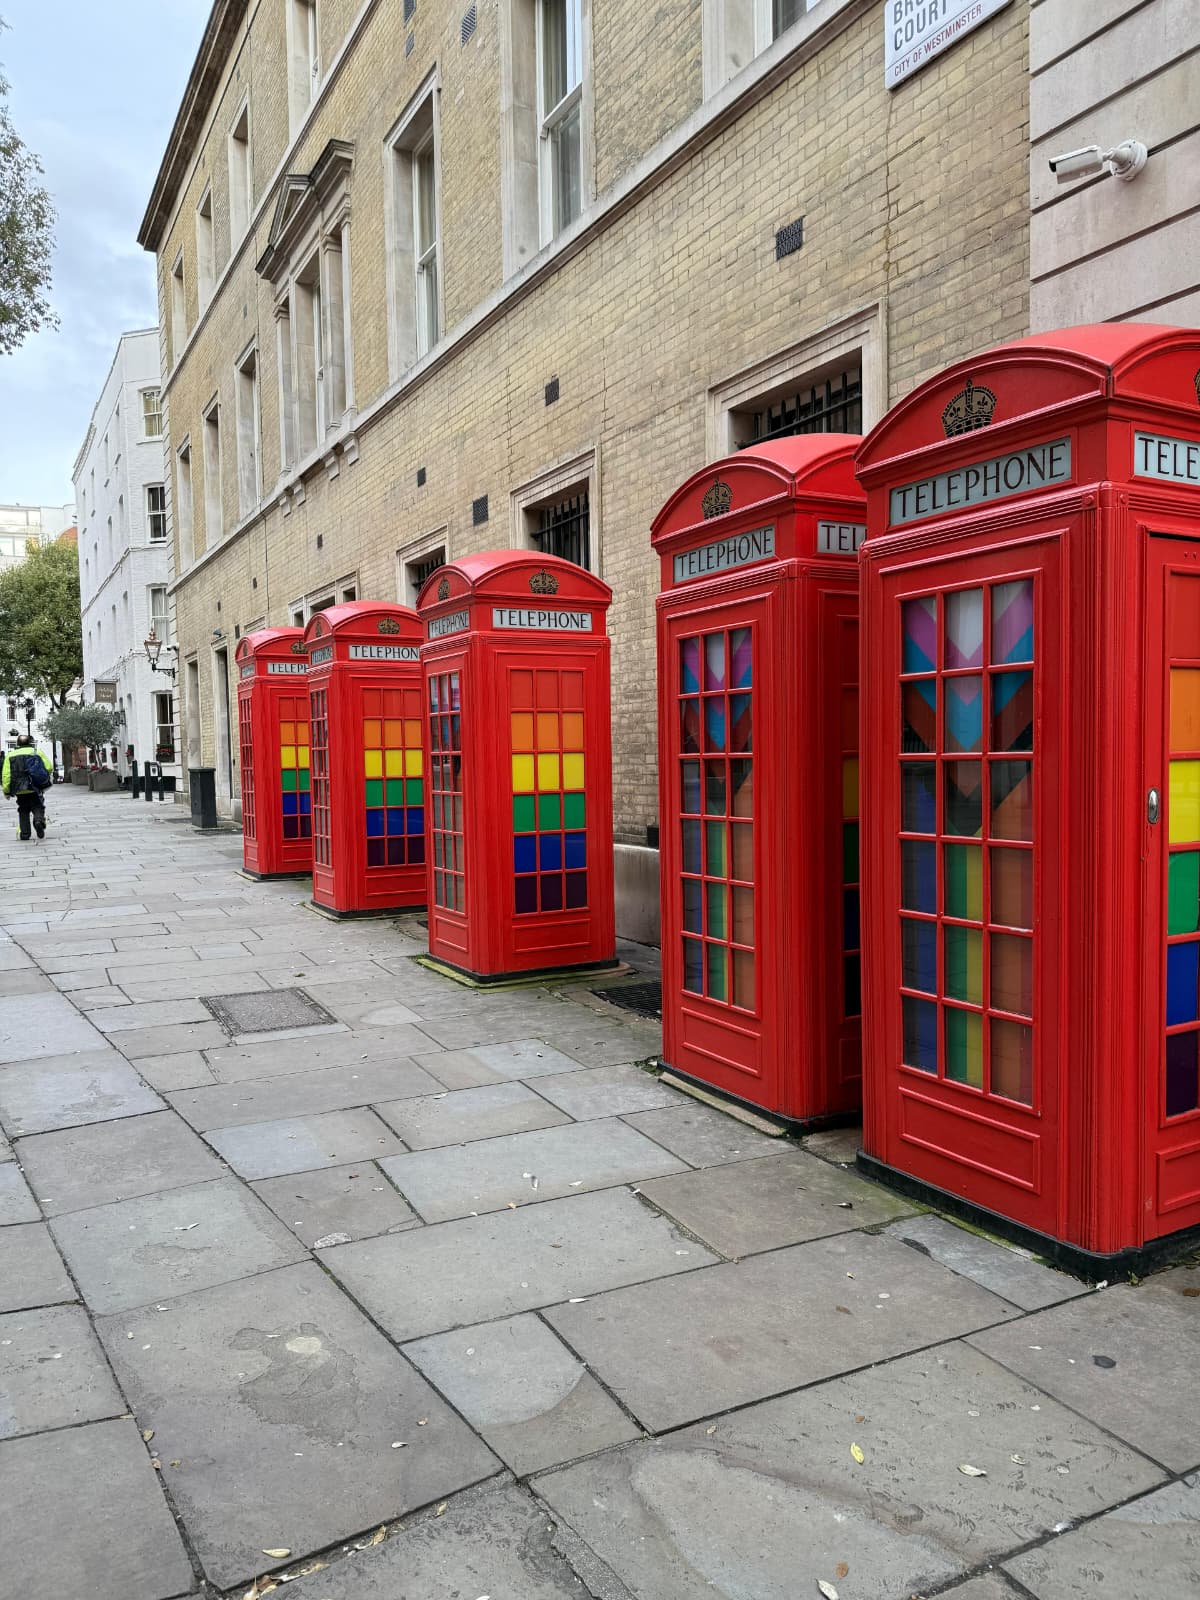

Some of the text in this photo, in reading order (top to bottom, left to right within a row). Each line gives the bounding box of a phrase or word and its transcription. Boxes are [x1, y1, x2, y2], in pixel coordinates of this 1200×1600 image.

[894, 0, 922, 25] BR
[894, 4, 983, 77] CITY OF WESTMINSTER
[1138, 436, 1199, 480] TELE
[896, 442, 1068, 518] TELEPHONE
[677, 527, 774, 577] TELEPHONE
[821, 523, 868, 552] TEL
[430, 611, 469, 637] TELEPHONE
[496, 608, 590, 629] TELEPHONE
